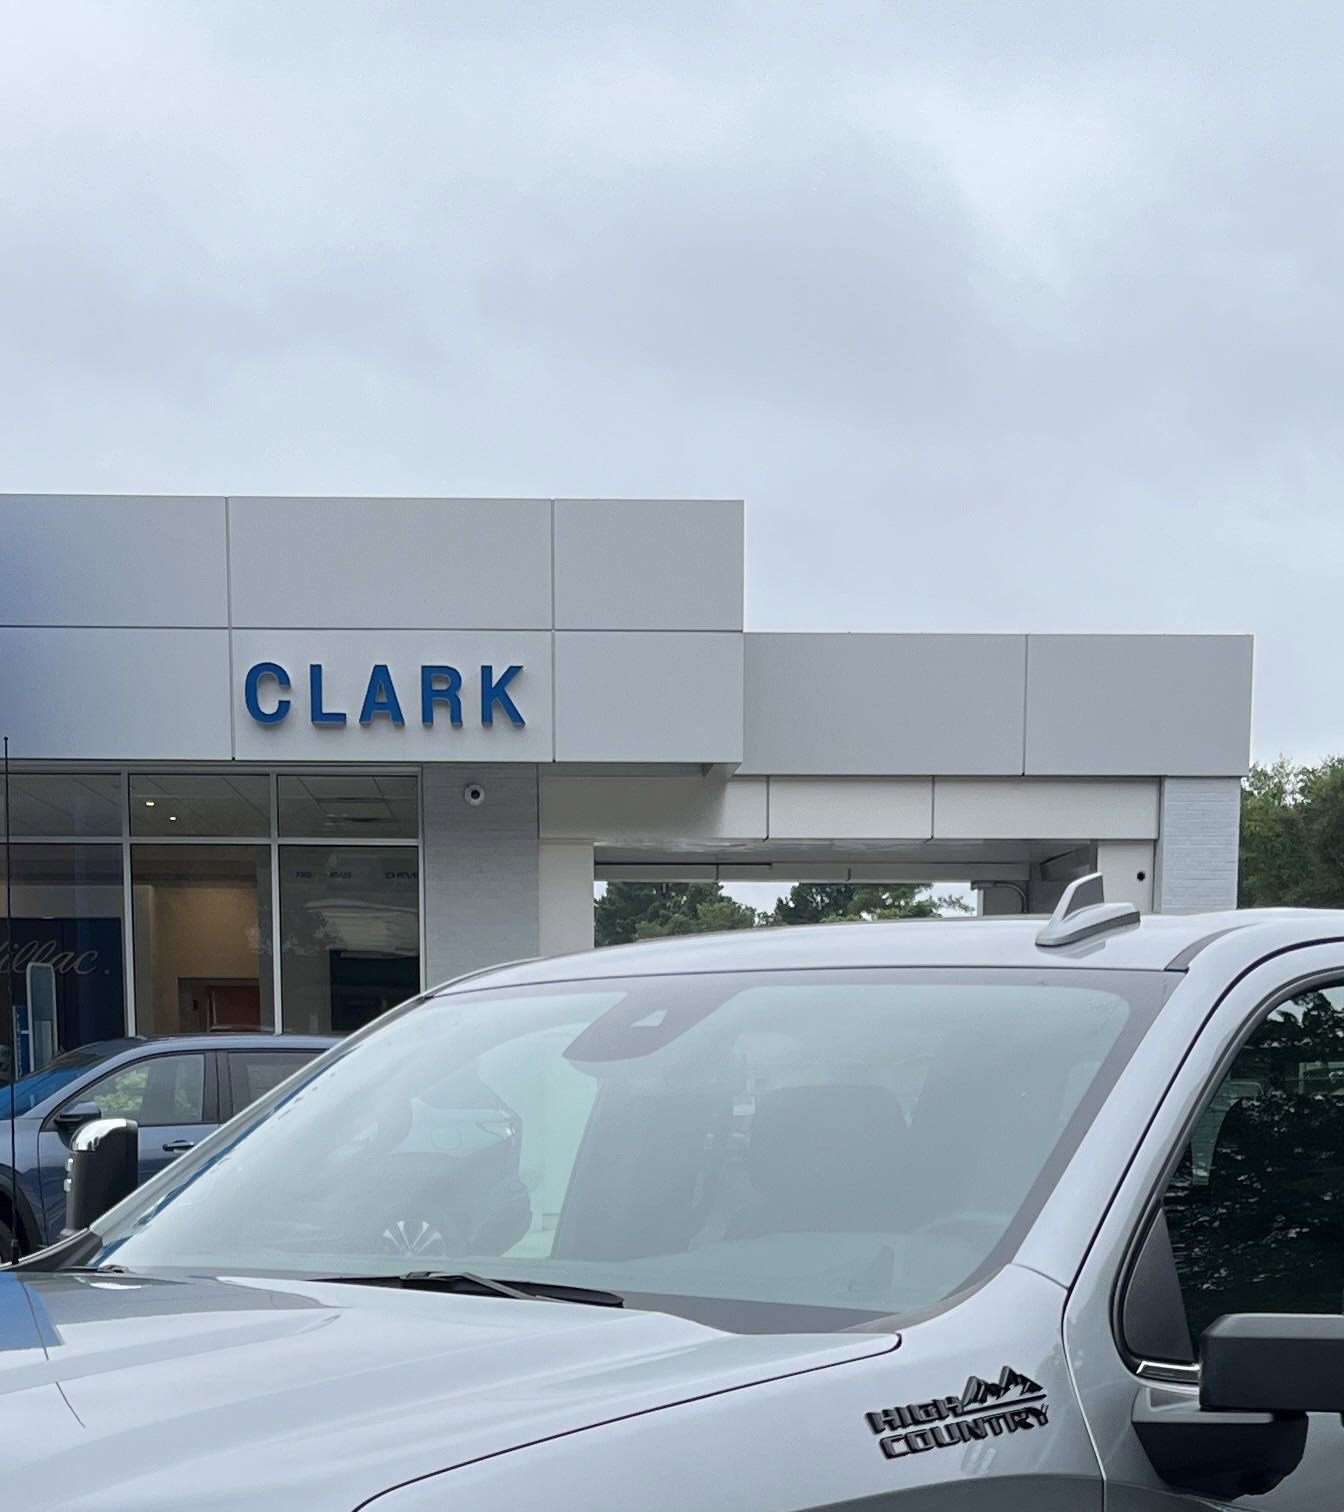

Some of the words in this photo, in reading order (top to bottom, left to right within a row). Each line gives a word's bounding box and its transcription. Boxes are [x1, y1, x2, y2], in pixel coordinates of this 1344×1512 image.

[244, 661, 526, 728] CLARK
[864, 1396, 965, 1434] HIGH
[879, 1404, 1050, 1460] COUNTRY
